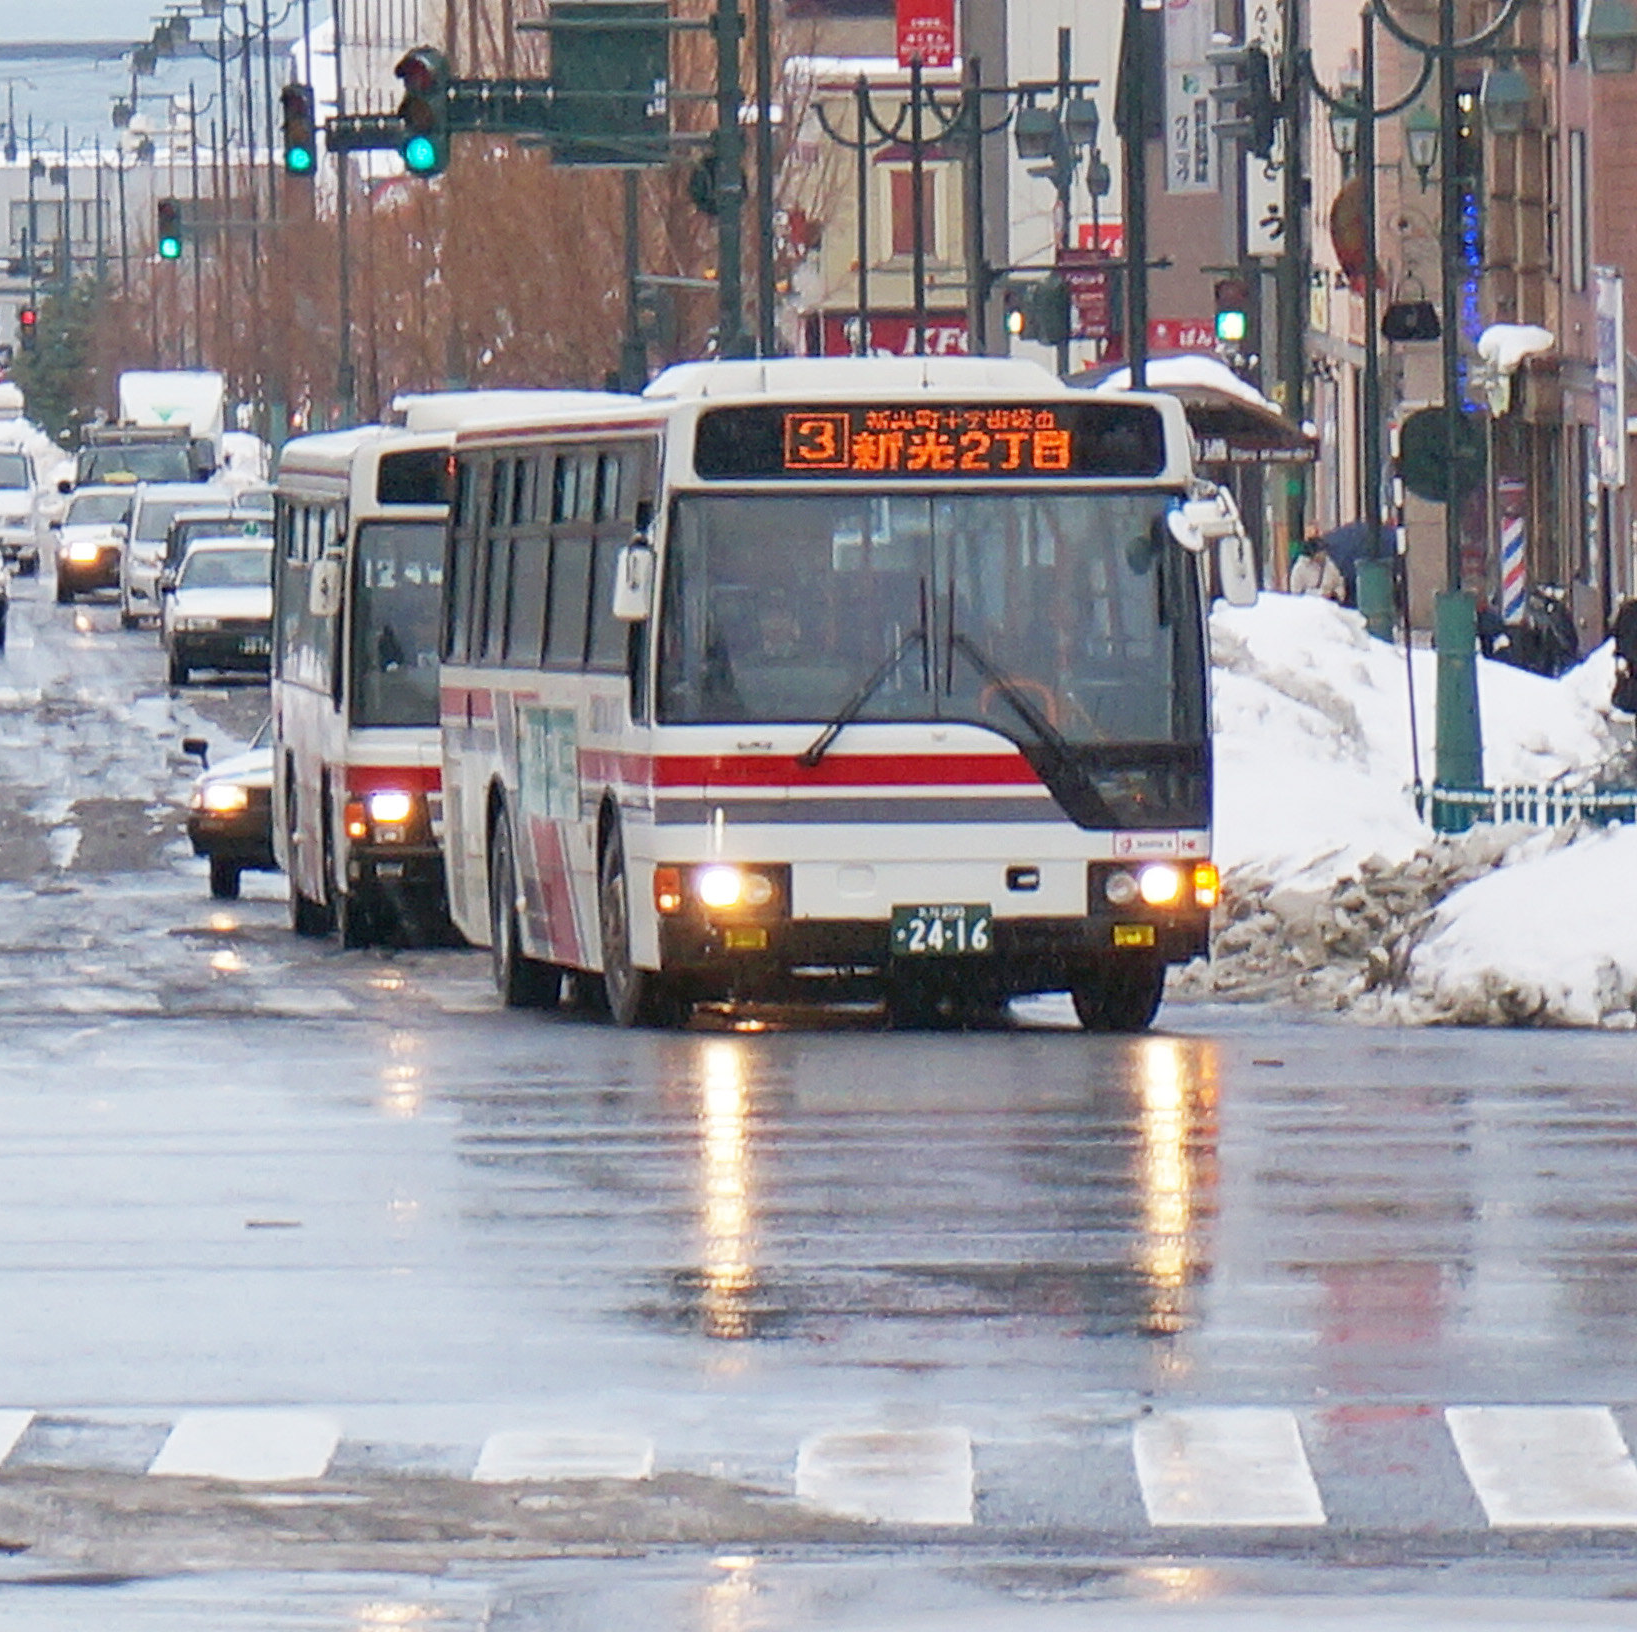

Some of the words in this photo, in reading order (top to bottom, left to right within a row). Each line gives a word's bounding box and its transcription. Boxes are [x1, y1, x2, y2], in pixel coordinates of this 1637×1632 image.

[798, 421, 835, 459] 3
[851, 430, 1072, 471] 新光2丁目
